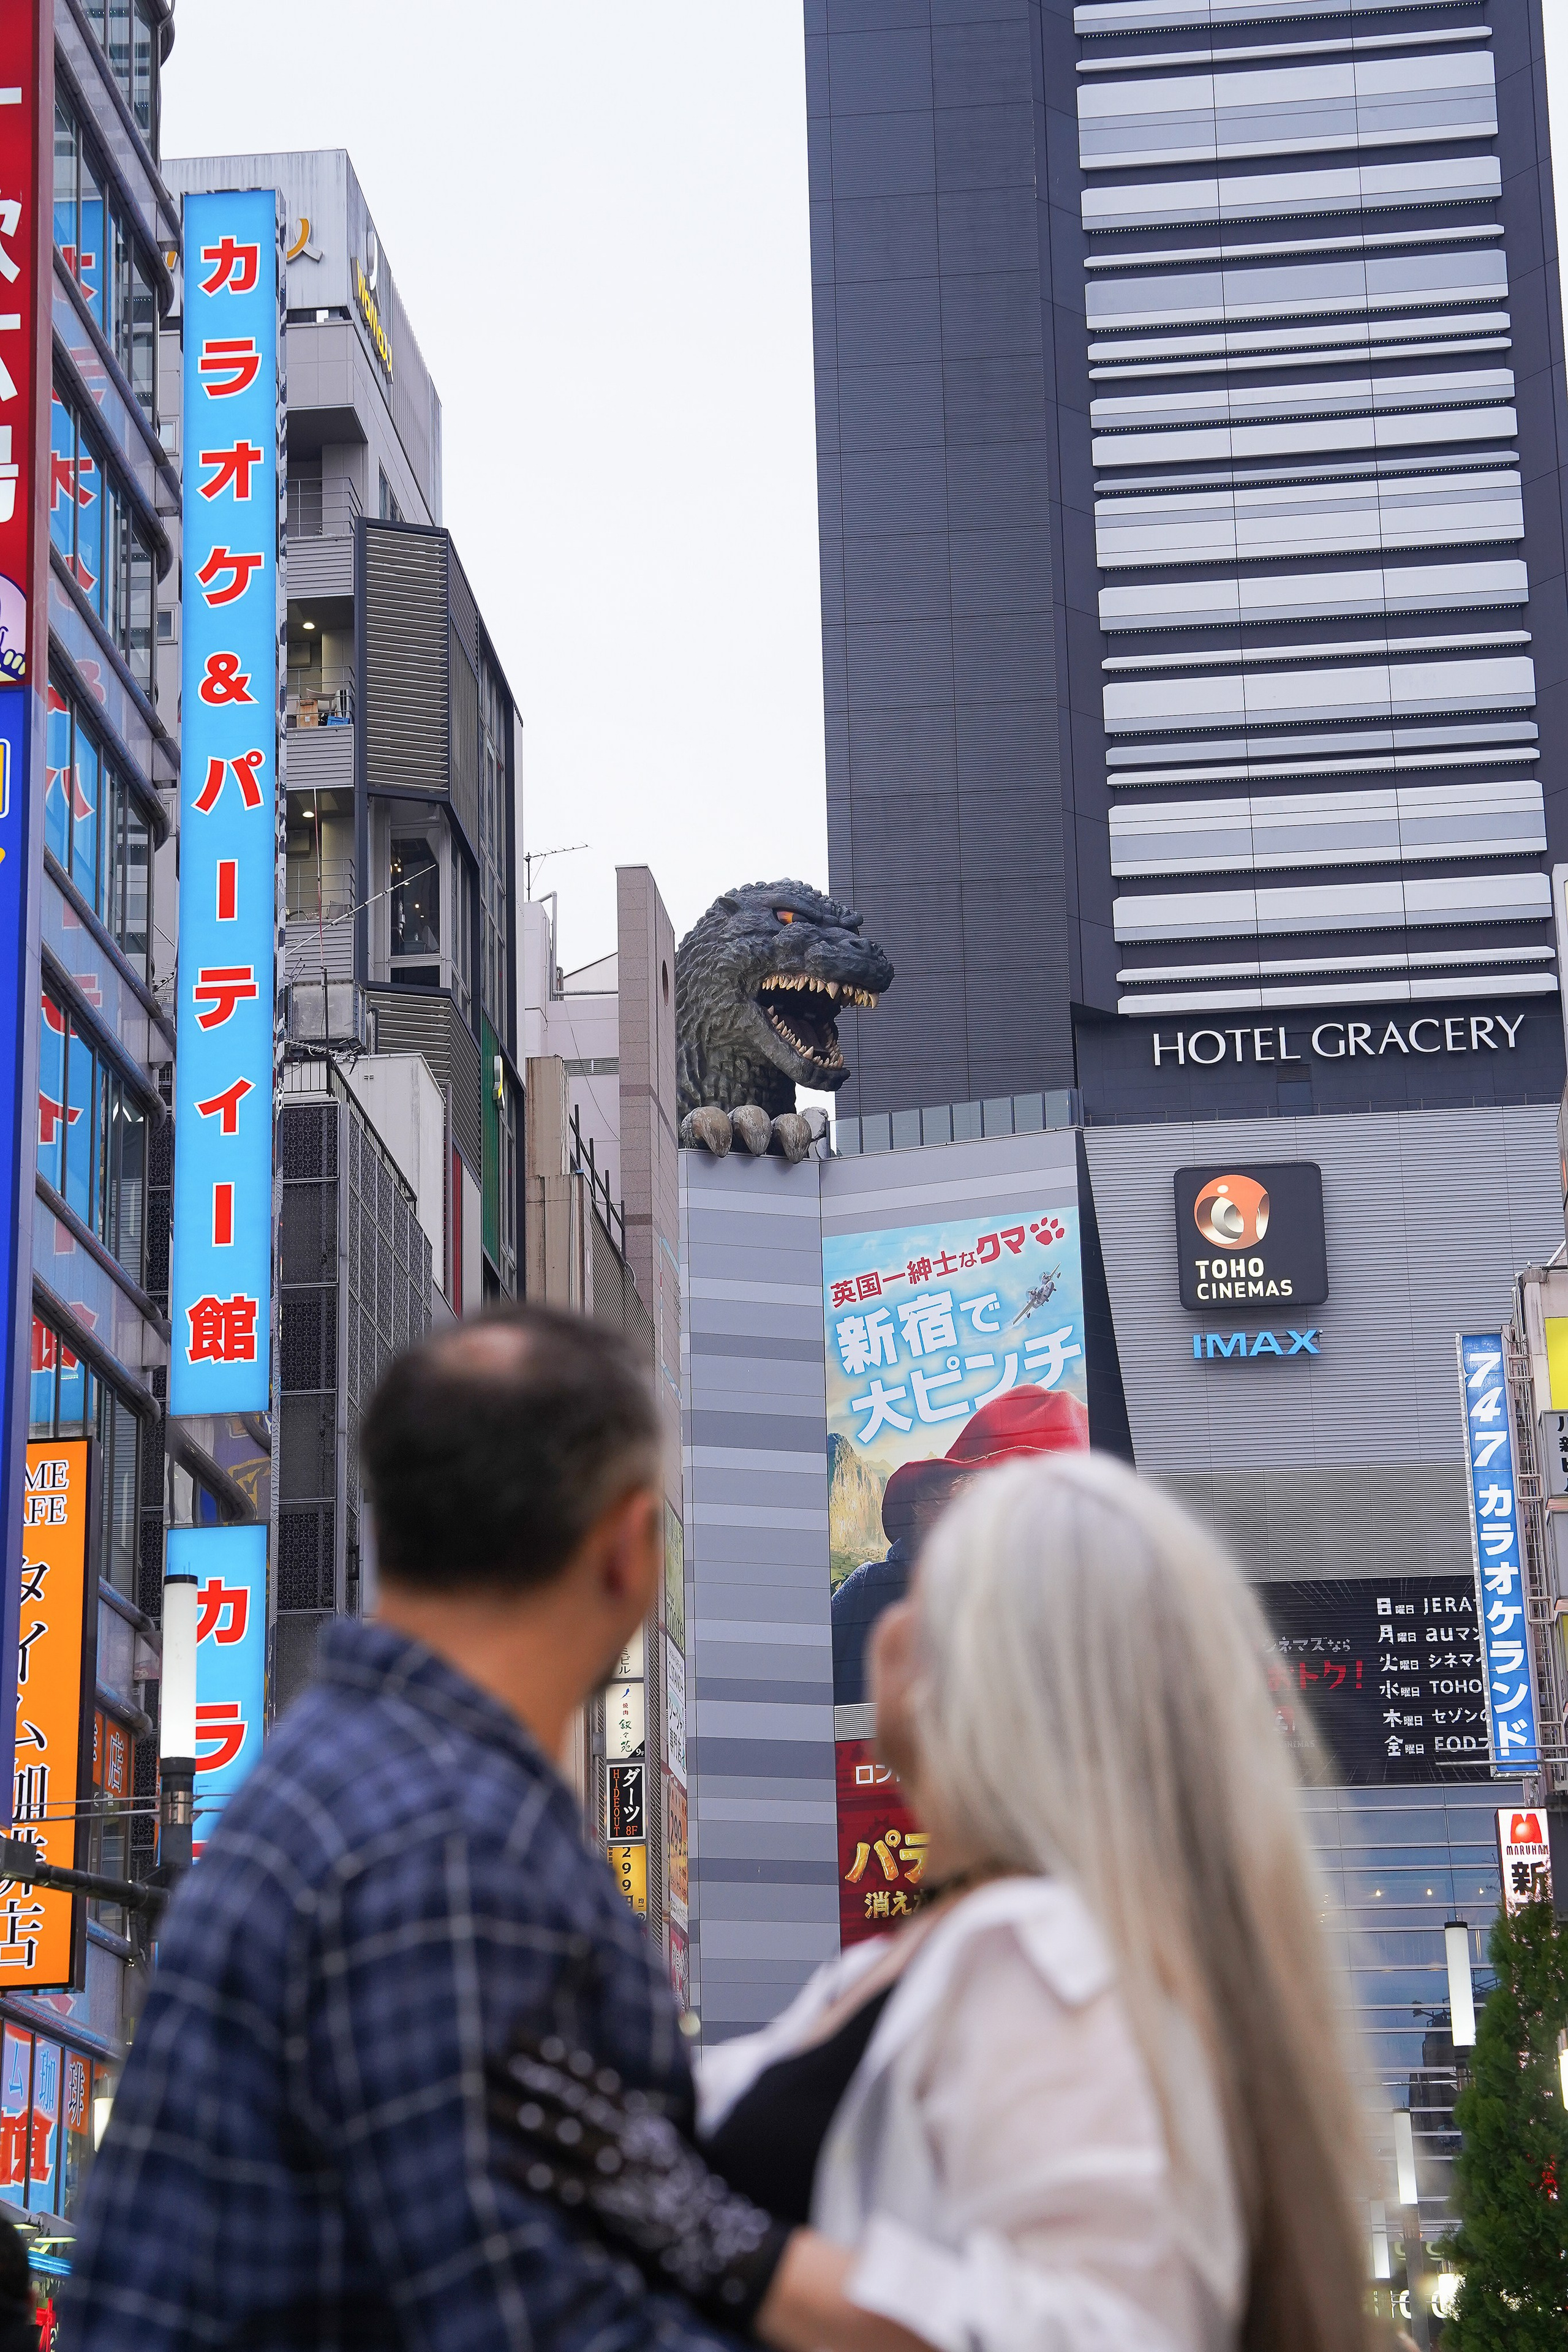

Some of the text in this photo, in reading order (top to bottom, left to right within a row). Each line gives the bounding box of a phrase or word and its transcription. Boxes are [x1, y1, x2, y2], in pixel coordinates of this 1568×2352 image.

[186, 235, 265, 1363] カラオケ&パーティー館
[1153, 1014, 1525, 1066] HOTEL GRACERY
[831, 1226, 1025, 1308] 英国一紳士なクマ
[1196, 1257, 1265, 1280] TOHO
[1197, 1280, 1293, 1300] CINEMAS
[836, 1291, 1001, 1374] 新宿で
[1193, 1330, 1321, 1359] IMAX
[851, 1325, 1082, 1444] 大ピンチ
[23, 1494, 68, 1526] FE
[1377, 1596, 1476, 1615] 日曜日 JERA
[1378, 1624, 1417, 1645] 月曜日
[1379, 1654, 1419, 1672] 火曜日
[1379, 1679, 1482, 1699] 水曜日 TOHO
[194, 1577, 251, 1860] カラ
[622, 1703, 629, 1715] 焼肉
[1383, 1709, 1423, 1727] 木曜日
[636, 1748, 644, 1757] 9F
[1384, 1735, 1425, 1757] 金曜日
[856, 1763, 900, 1785] ロン
[622, 1768, 641, 1823] ダーツ
[626, 1825, 638, 1836] 8F
[1511, 1861, 1547, 1912] 新
